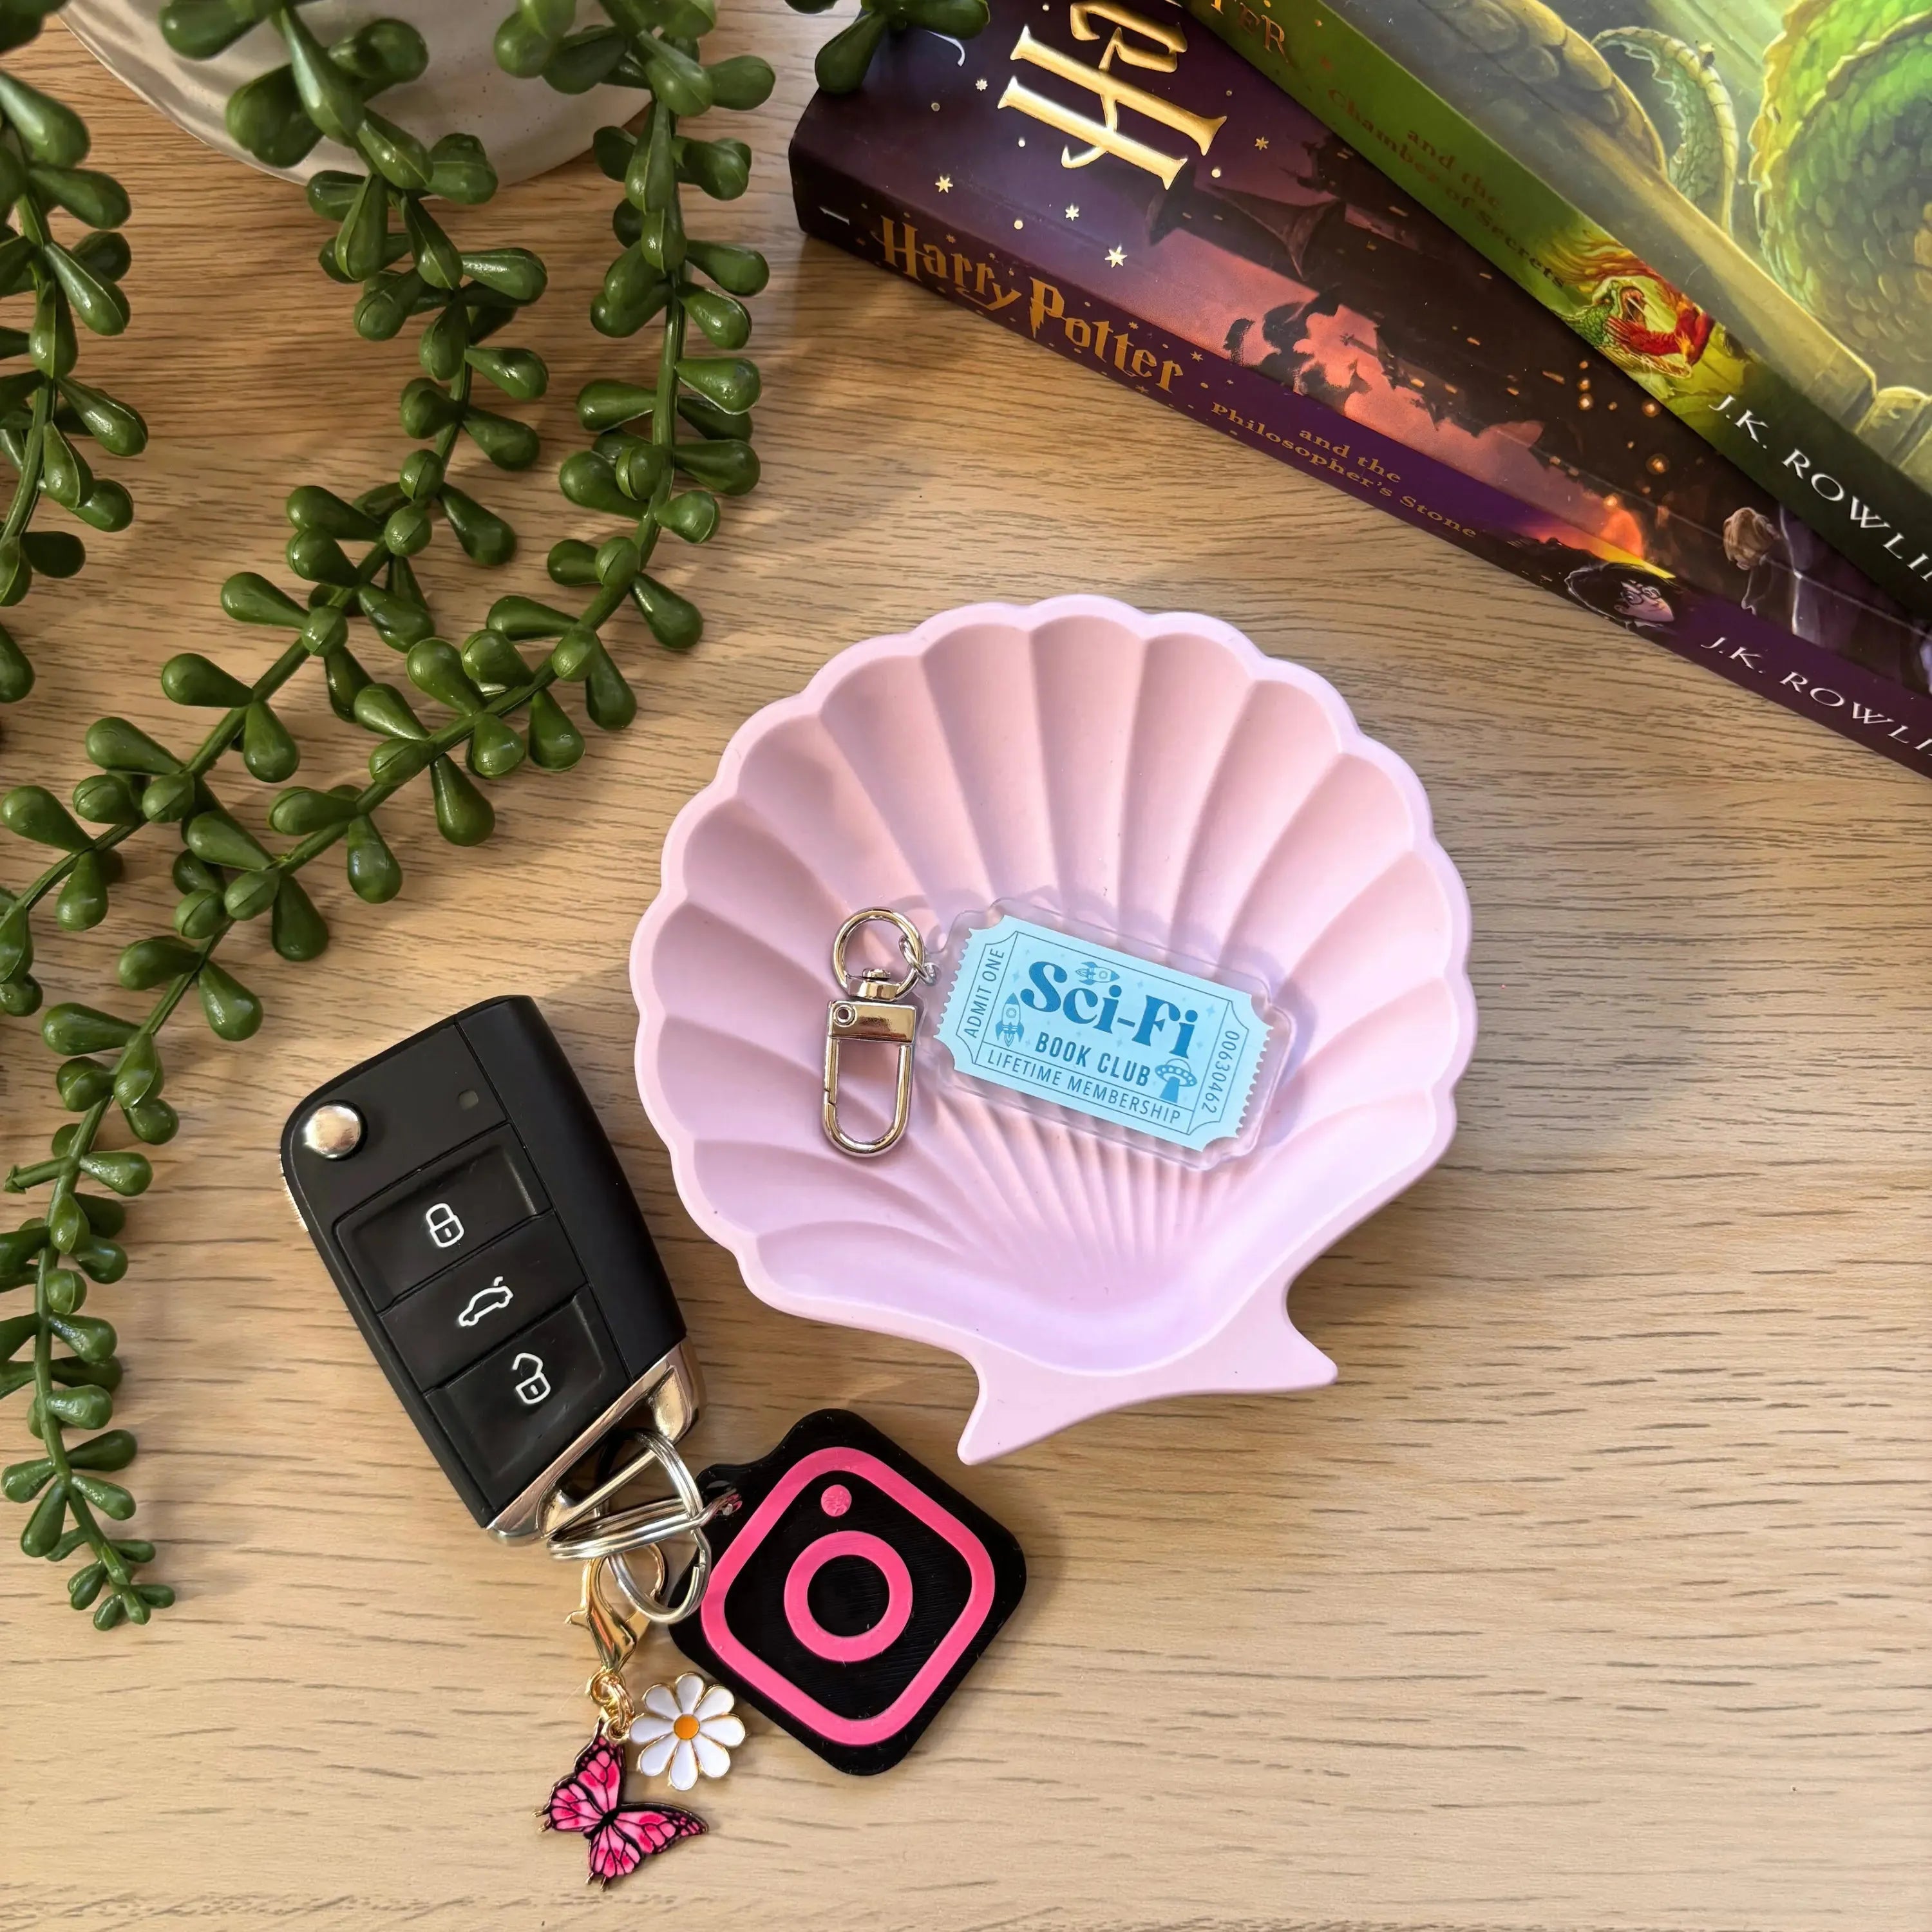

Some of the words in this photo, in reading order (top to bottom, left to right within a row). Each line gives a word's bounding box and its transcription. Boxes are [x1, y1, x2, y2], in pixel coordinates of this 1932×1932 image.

[998, 0, 1227, 190] Ha
[1406, 129, 1455, 171] and
[1475, 209, 1566, 289] Secrets
[870, 214, 1022, 310] Harry
[1029, 276, 1184, 394] Potter
[1211, 401, 1394, 497] Philosopher's
[1399, 495, 1478, 538] Stone
[1298, 429, 1351, 458] and
[1358, 455, 1402, 483] the
[1708, 394, 1769, 450] J.K.
[1781, 448, 1932, 582] ROWLI
[1701, 636, 1765, 674] J.K.
[1779, 670, 1932, 757] ROWLI
[963, 985, 992, 1039] ADMIT
[981, 947, 1005, 981] ONE
[1019, 961, 1198, 1059] Sci-Fi
[987, 1049, 1062, 1087] LIFETIME
[1067, 1077, 1181, 1124] MEMBERSHIP
[1035, 1032, 1091, 1068] BOOK
[1097, 1052, 1151, 1087] CLUB
[1201, 1030, 1240, 1113] 00630462
